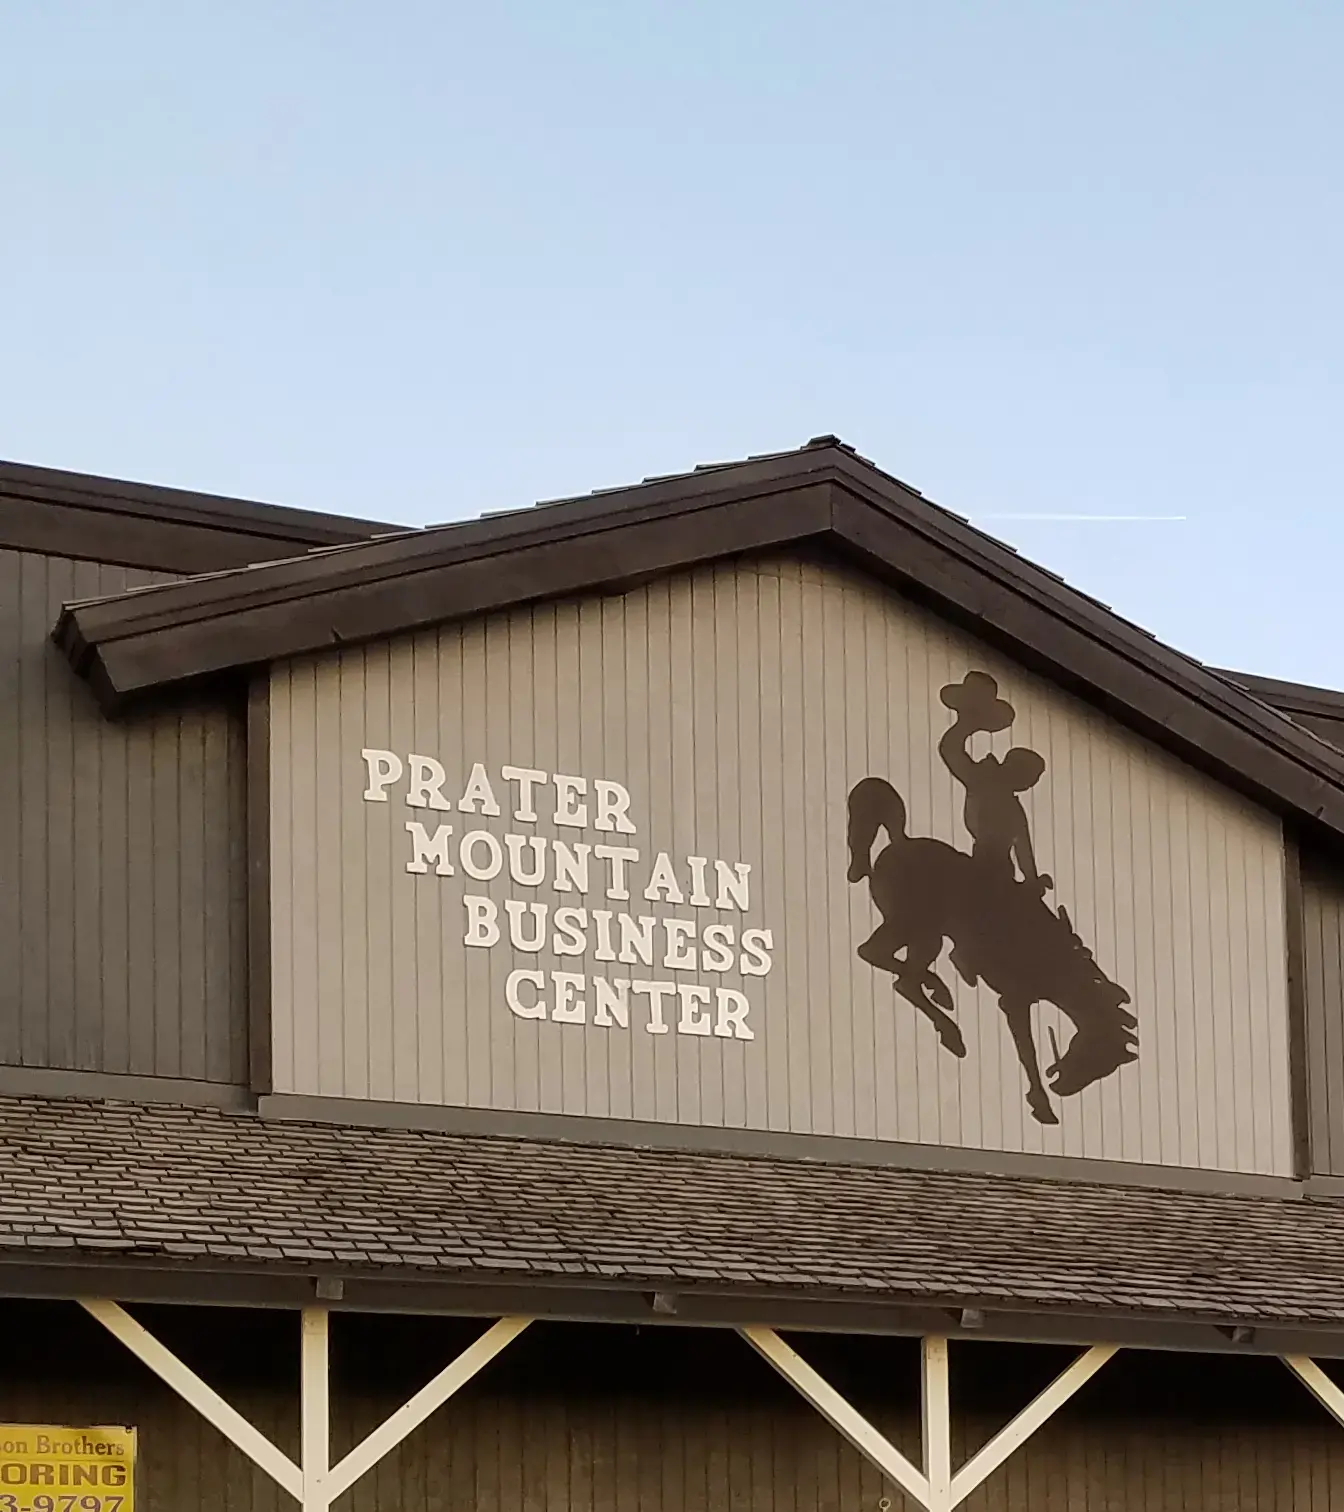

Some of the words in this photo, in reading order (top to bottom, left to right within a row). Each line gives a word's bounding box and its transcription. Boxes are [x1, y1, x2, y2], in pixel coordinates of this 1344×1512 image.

[362, 748, 637, 834] PRATER
[405, 821, 752, 912] MOUNTAIN
[463, 895, 774, 977] BUSINESS
[505, 969, 755, 1041] CENTER
[0, 1440, 29, 1454] on
[36, 1434, 125, 1456] Brothers
[1, 1463, 126, 1486] ORING
